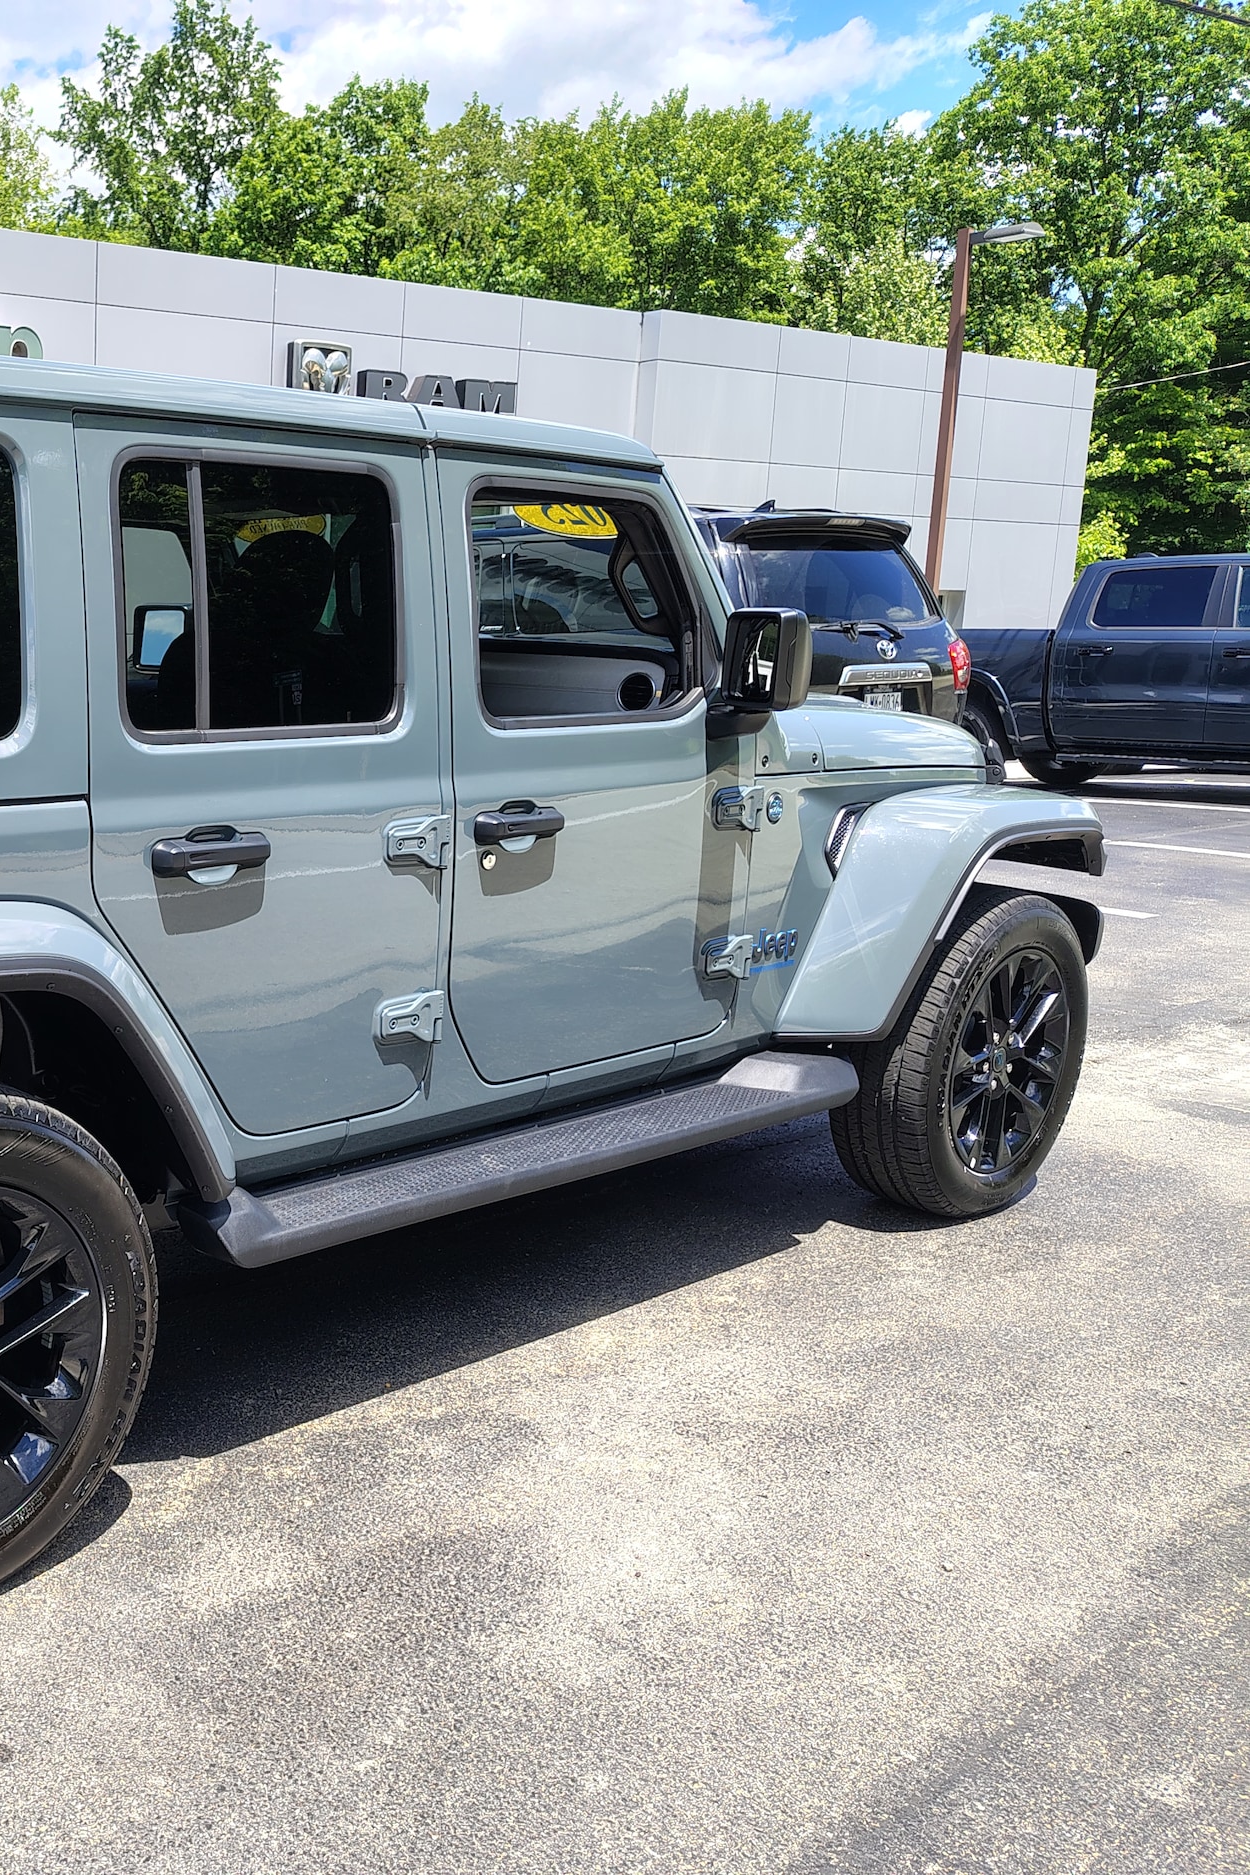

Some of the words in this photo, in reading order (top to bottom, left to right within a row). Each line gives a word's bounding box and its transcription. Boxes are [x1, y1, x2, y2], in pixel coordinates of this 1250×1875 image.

[357, 369, 518, 415] RAM
[865, 669, 919, 681] SEQUOIA
[751, 927, 799, 963] Jeep
